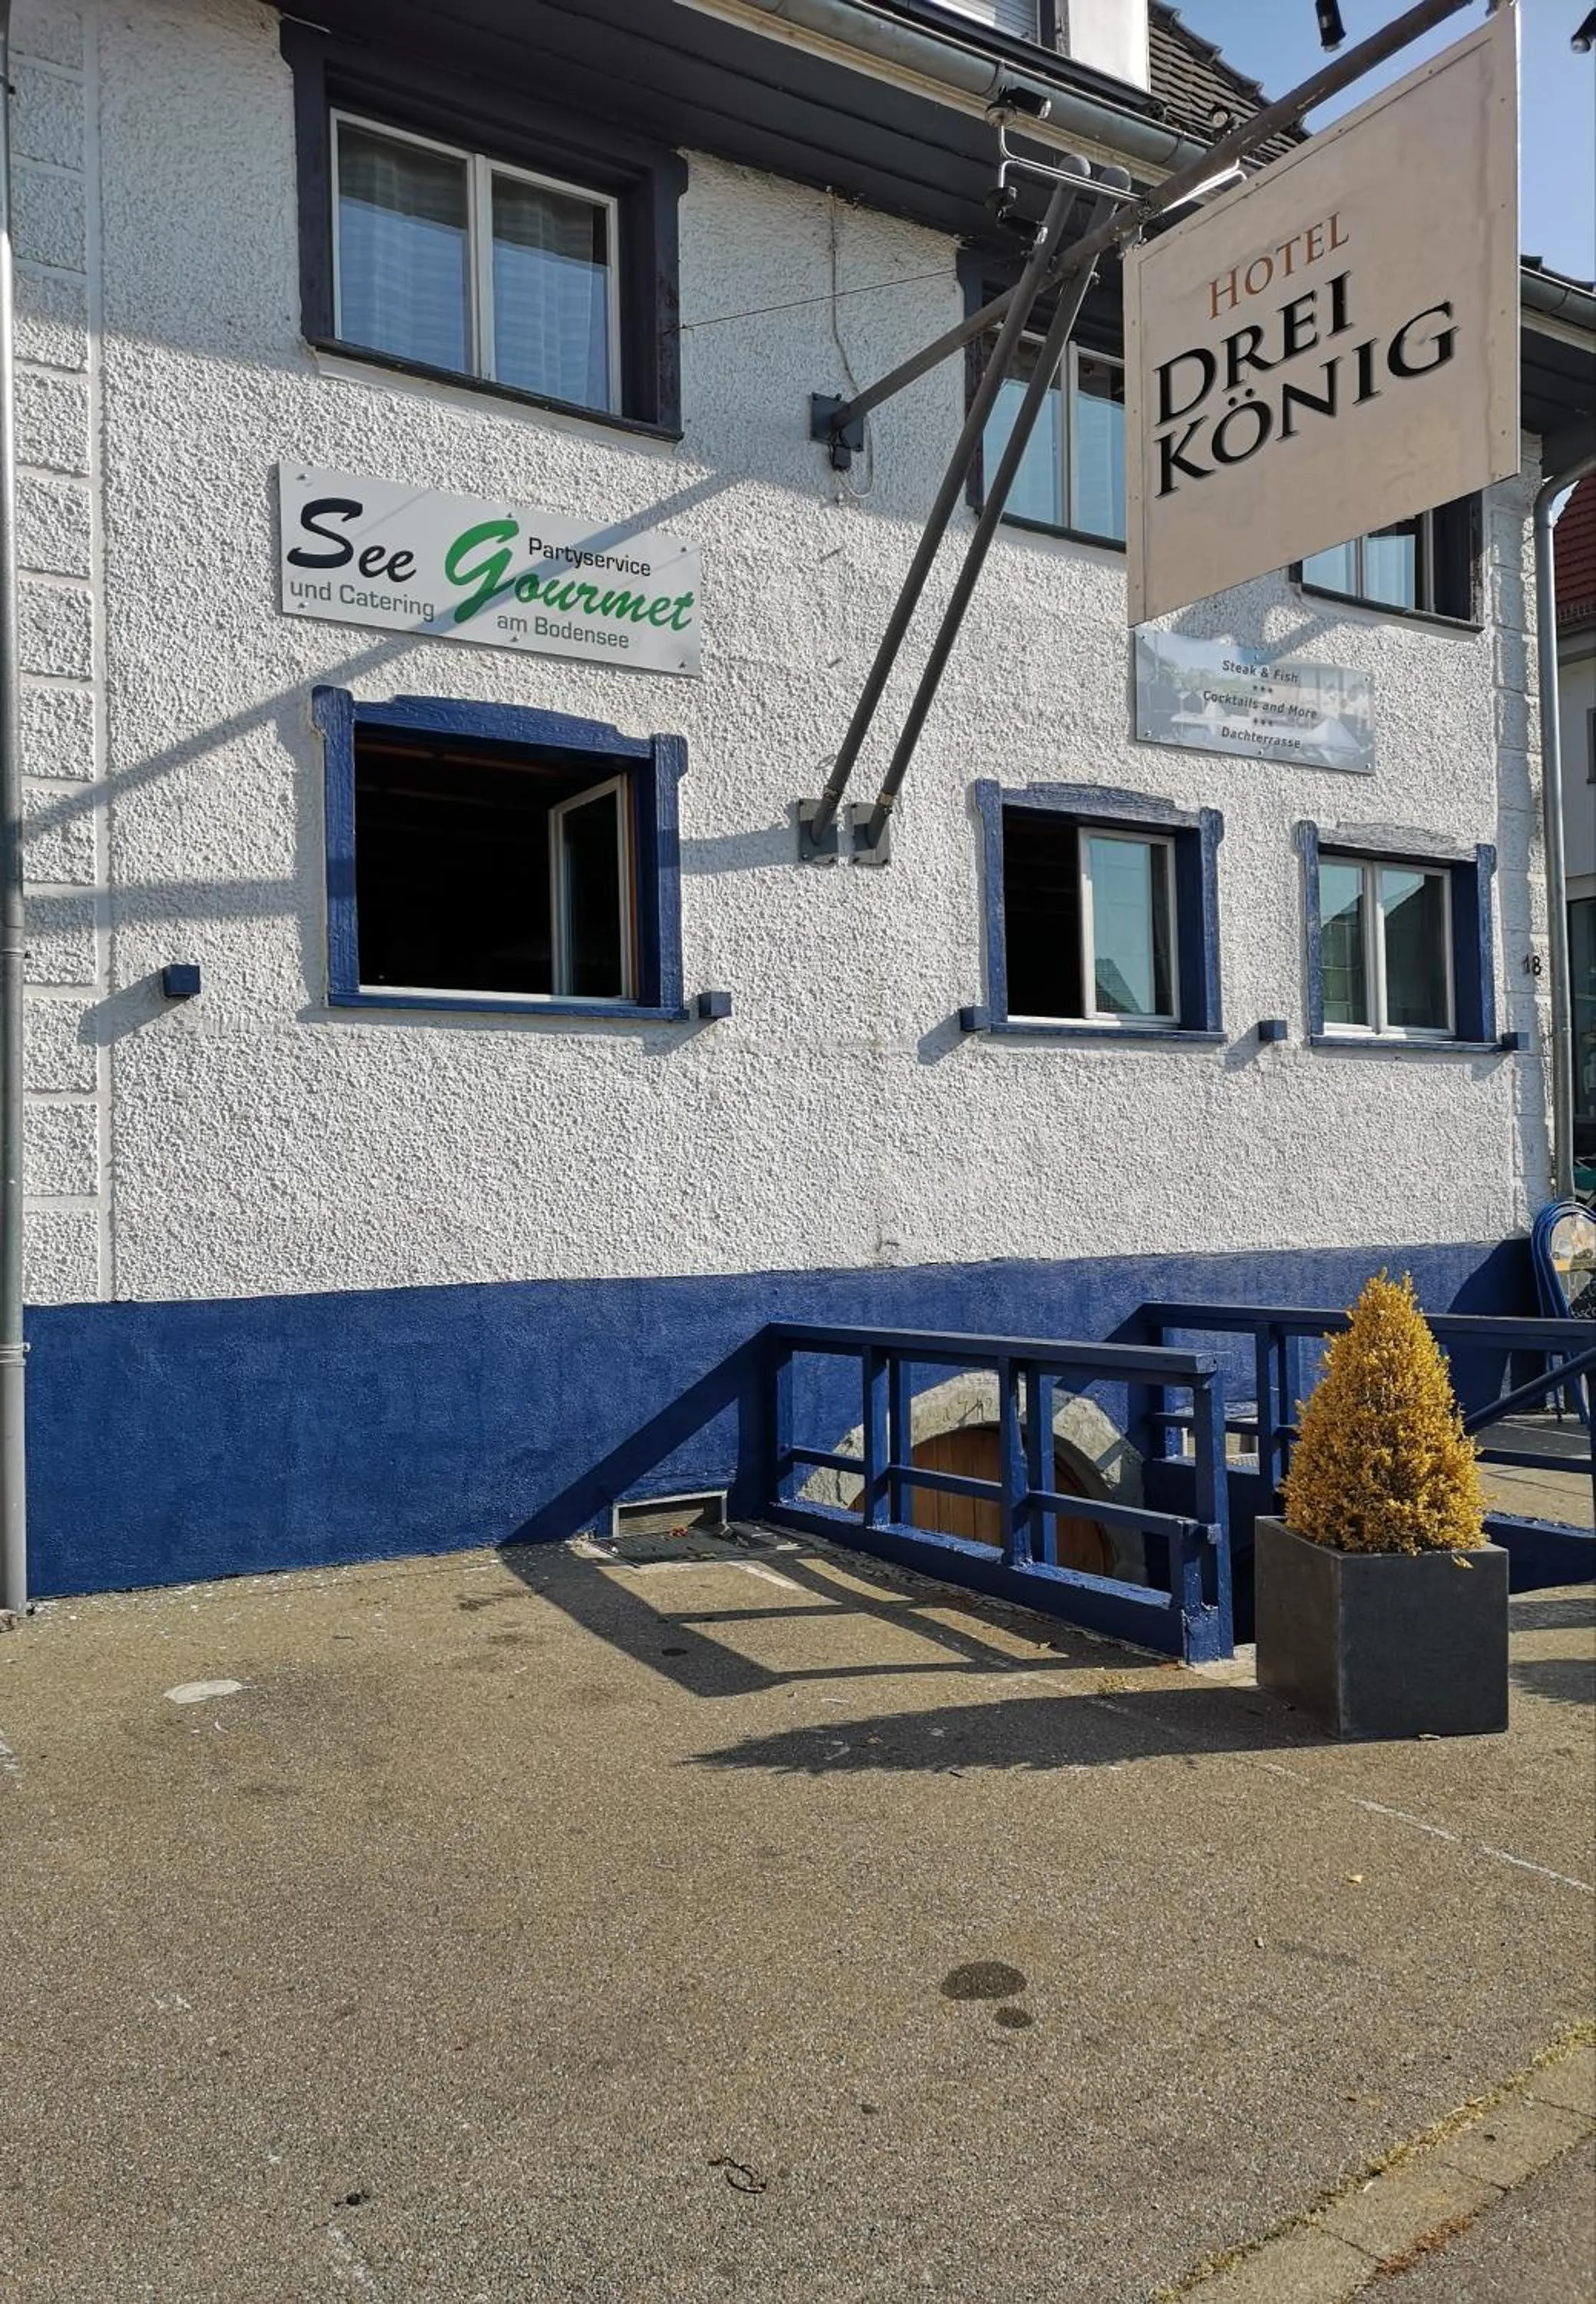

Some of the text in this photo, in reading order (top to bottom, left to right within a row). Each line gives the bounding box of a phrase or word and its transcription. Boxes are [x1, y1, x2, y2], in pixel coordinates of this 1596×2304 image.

[1208, 212, 1349, 320] HOTEL
[1154, 270, 1354, 428] DREI
[1154, 300, 1460, 499] KÖNIG
[287, 497, 694, 631] See Gourmet
[528, 537, 651, 577] Partyservice
[290, 578, 435, 622] und Catering
[497, 614, 630, 649] am Bodensee
[1222, 660, 1298, 684] Steak & Fish
[1203, 690, 1318, 720] Cocktails and More
[1221, 726, 1300, 749] Dachterrasse
[1522, 954, 1541, 975] 18
